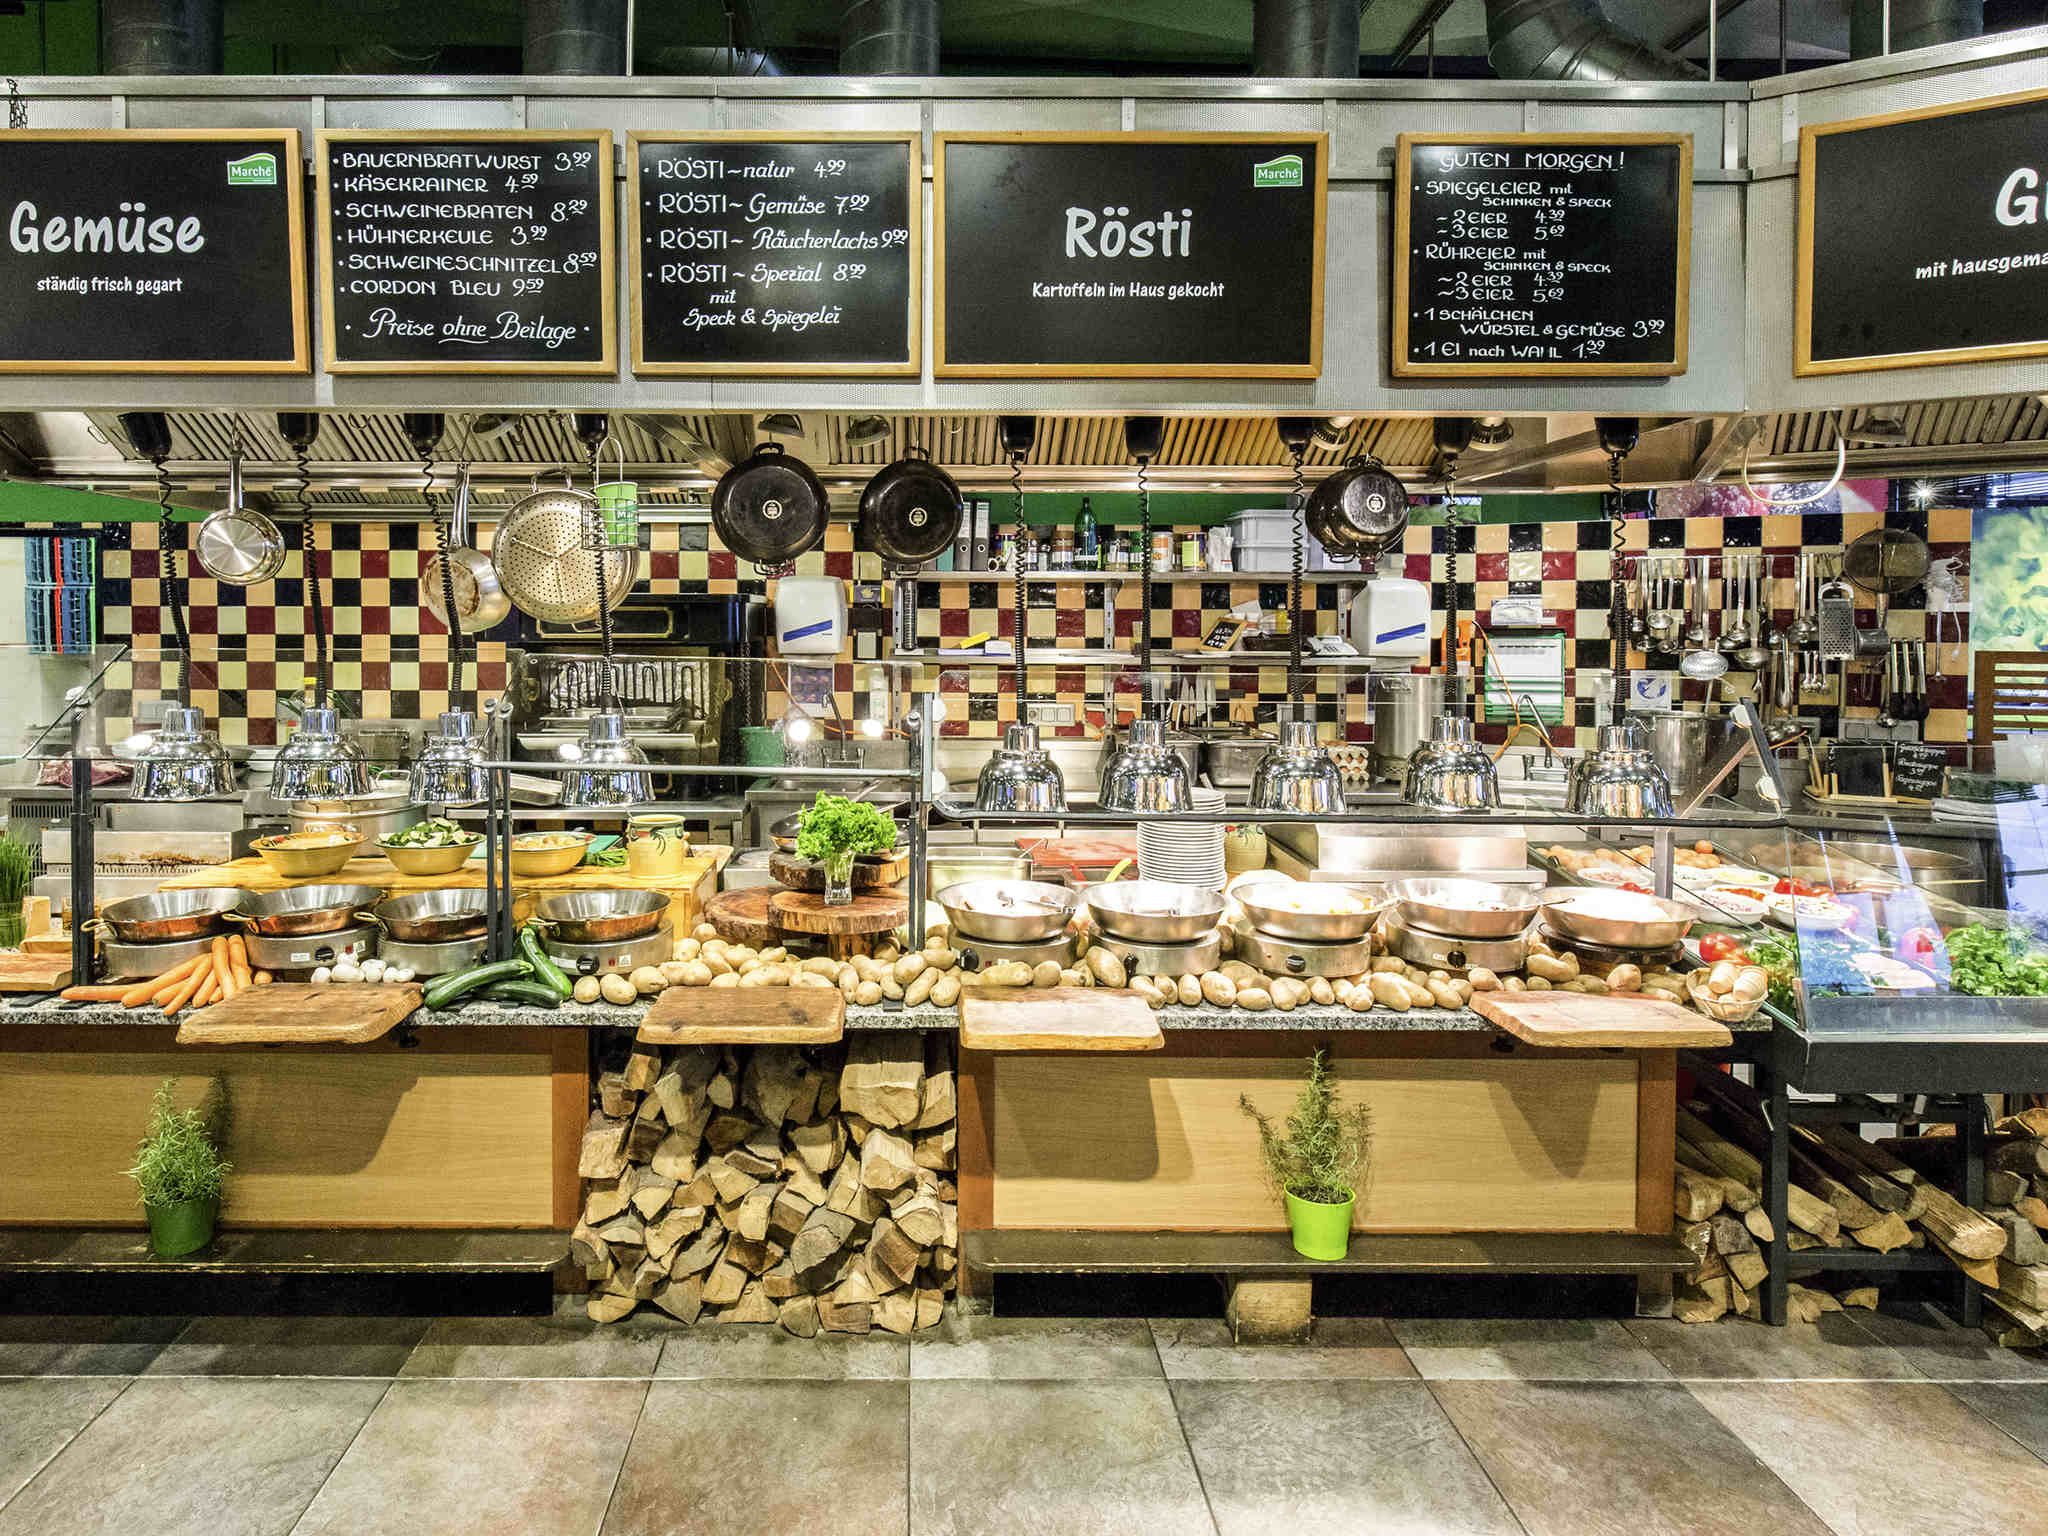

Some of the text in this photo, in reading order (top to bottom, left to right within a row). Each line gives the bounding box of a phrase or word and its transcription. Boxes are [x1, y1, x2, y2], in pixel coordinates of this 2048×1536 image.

[343, 153, 541, 170] BAUERNBRATWURST
[1440, 151, 1509, 173] GUTEN
[345, 174, 488, 192] KÄSEKRAINER
[1426, 181, 1572, 199] SPIEGELEIER mit
[1483, 197, 1551, 207] SCHINKEN
[1569, 199, 1611, 207] SPECK
[1996, 168, 2048, 226] G
[346, 203, 532, 219] SCHWEINEBRATEN
[10, 201, 204, 253] Gemüse
[348, 225, 493, 244] HÜHNERKEULE
[1066, 207, 1192, 258] Rösti
[752, 227, 878, 249] Räucherlachs
[1426, 242, 1545, 259] RÜHREIER mit
[349, 254, 561, 273] SCHWEINESCHNITZEL
[1484, 261, 1550, 270] SCHINKEN
[1568, 263, 1611, 273] SPECK
[1916, 262, 1947, 279] mit
[751, 262, 822, 288] Spezial
[37, 276, 182, 295] ständig frisch gegart
[351, 280, 435, 295] CORDON
[450, 280, 500, 296] BLEU
[1033, 282, 1224, 300] Kartoffeln im Haus gekocht
[710, 290, 736, 303] mit
[683, 305, 842, 332] Speck & Spiegelei
[1440, 307, 1533, 322] SCHÄLCHEN
[363, 308, 576, 348] Preise ohne Beilage
[1460, 321, 1539, 336] WÜRSTEL
[1555, 322, 1625, 341] GEMÜSE
[1424, 342, 1435, 355] 1
[1469, 346, 1504, 356] nach
